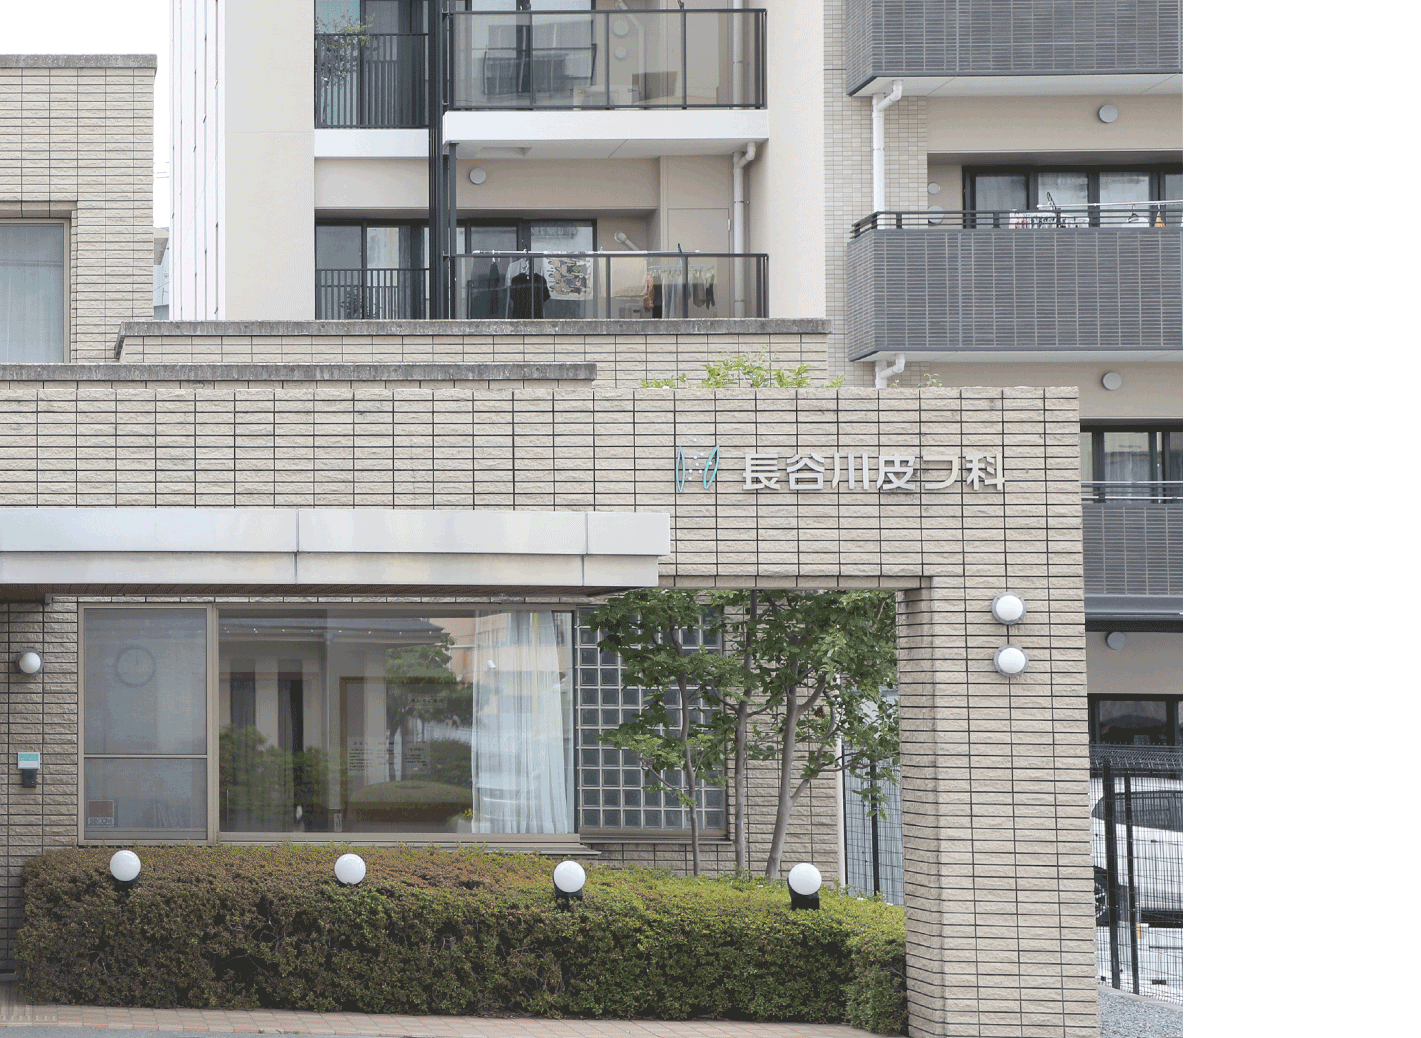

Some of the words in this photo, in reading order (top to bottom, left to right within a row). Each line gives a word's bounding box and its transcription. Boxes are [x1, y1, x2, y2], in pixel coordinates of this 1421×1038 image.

[742, 452, 1005, 491] 長谷川皮フ科
